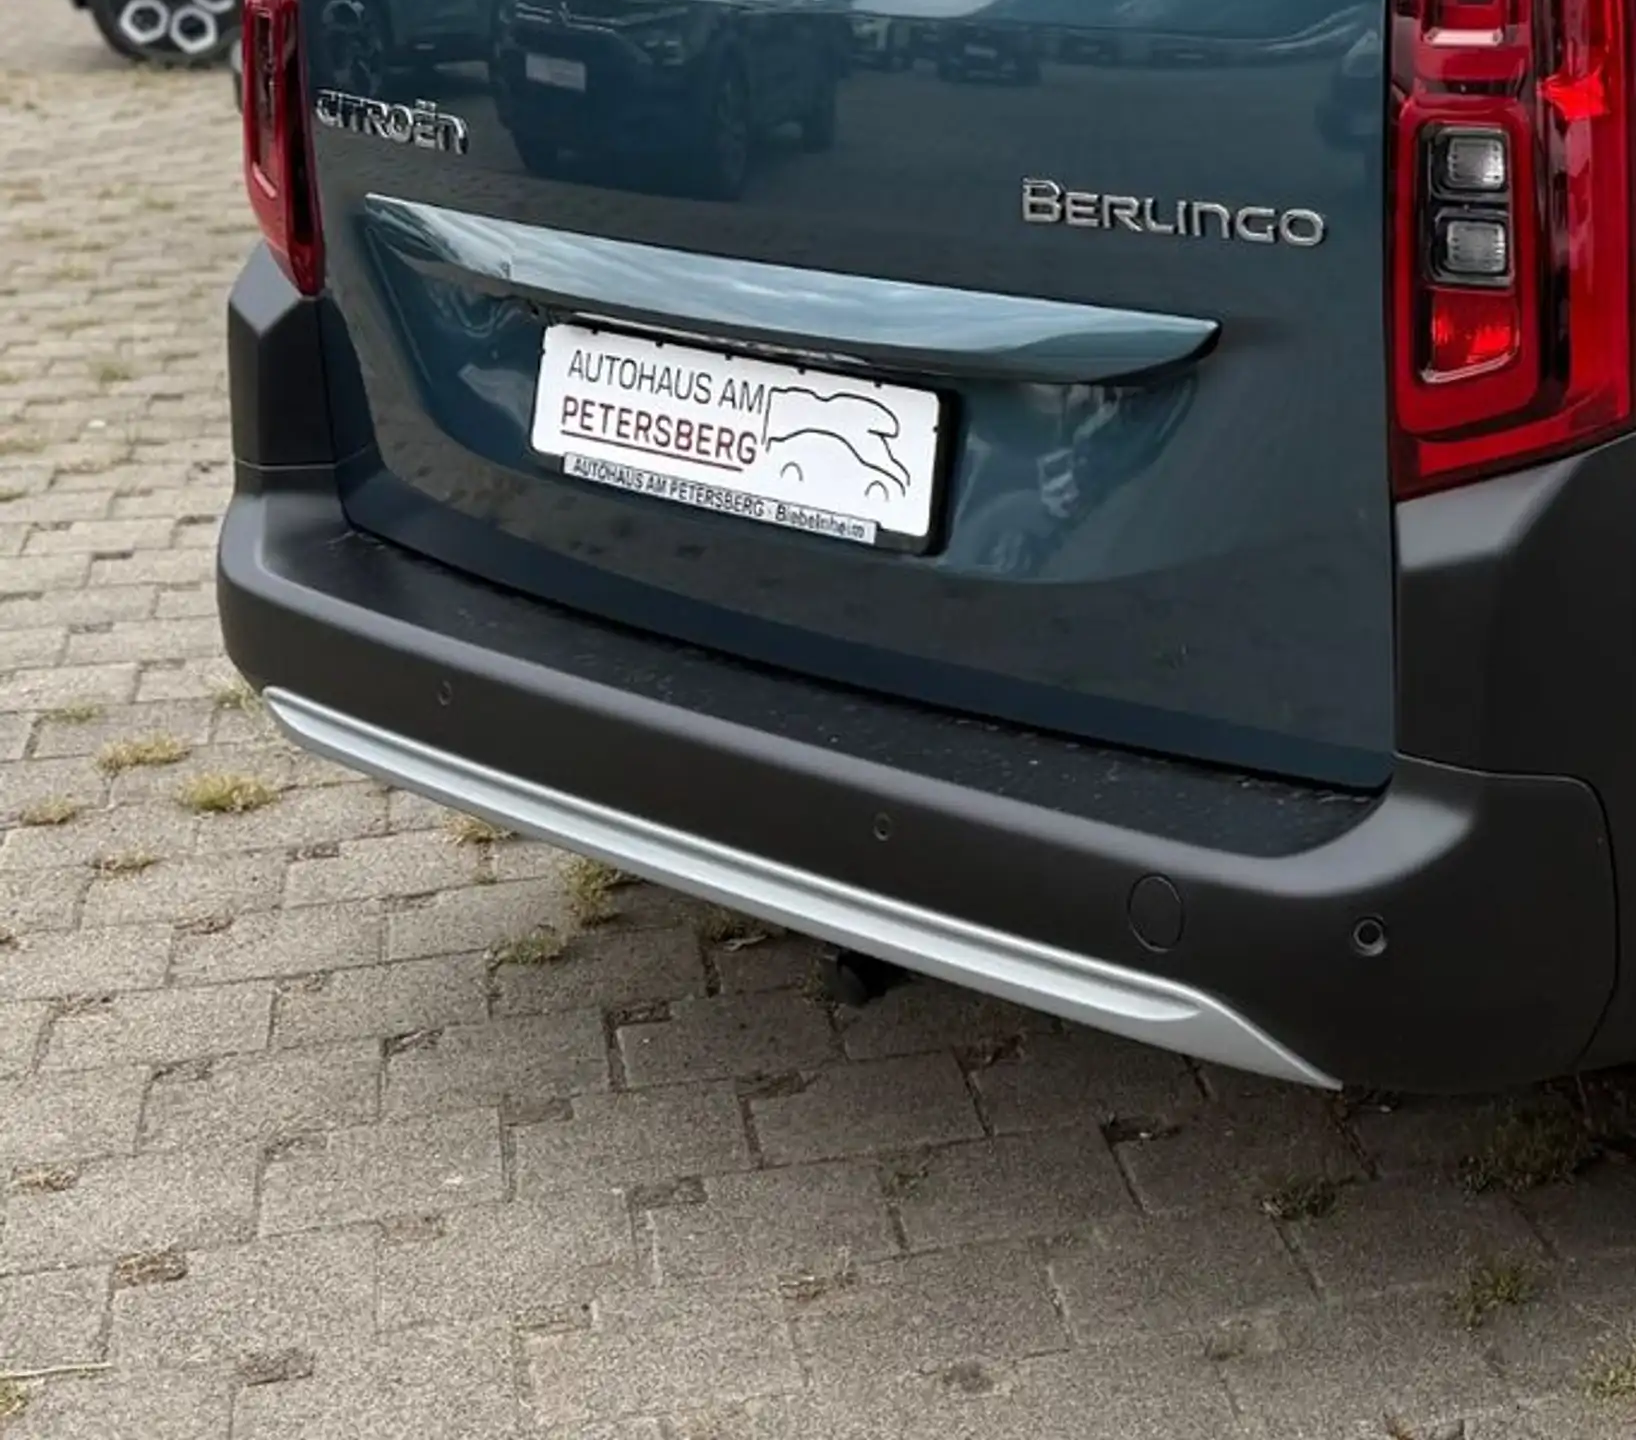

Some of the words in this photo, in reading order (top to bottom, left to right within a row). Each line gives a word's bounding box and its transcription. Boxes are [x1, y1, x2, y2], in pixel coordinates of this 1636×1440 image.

[567, 349, 713, 405] AUTOHAUS
[717, 377, 766, 415] AM
[560, 395, 759, 466] PETERSBERG
[572, 458, 643, 489] AUTOHAUS
[645, 474, 668, 497] AM
[668, 480, 765, 519] PETERSBERG
